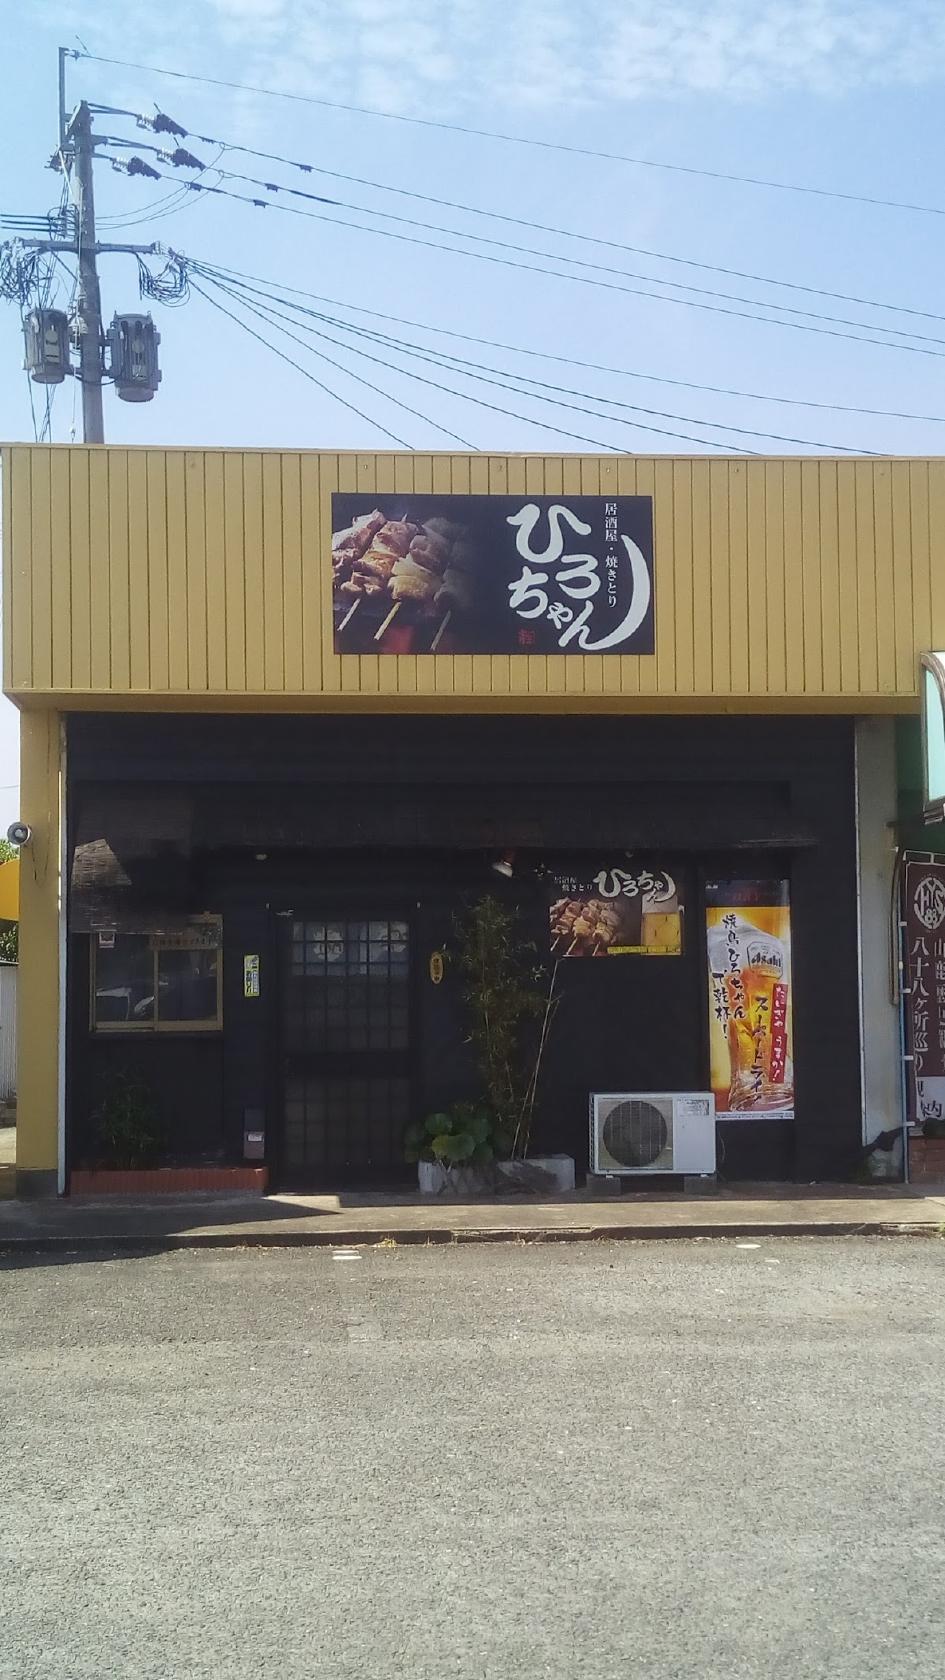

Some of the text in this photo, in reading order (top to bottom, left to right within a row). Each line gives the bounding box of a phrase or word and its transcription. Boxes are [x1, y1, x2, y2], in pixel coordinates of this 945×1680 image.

[506, 503, 650, 650] ひろちゃん
[605, 502, 618, 608] 居酒屋・焼きとり
[593, 868, 676, 902] ひろちゃん
[751, 951, 782, 968] Asahi
